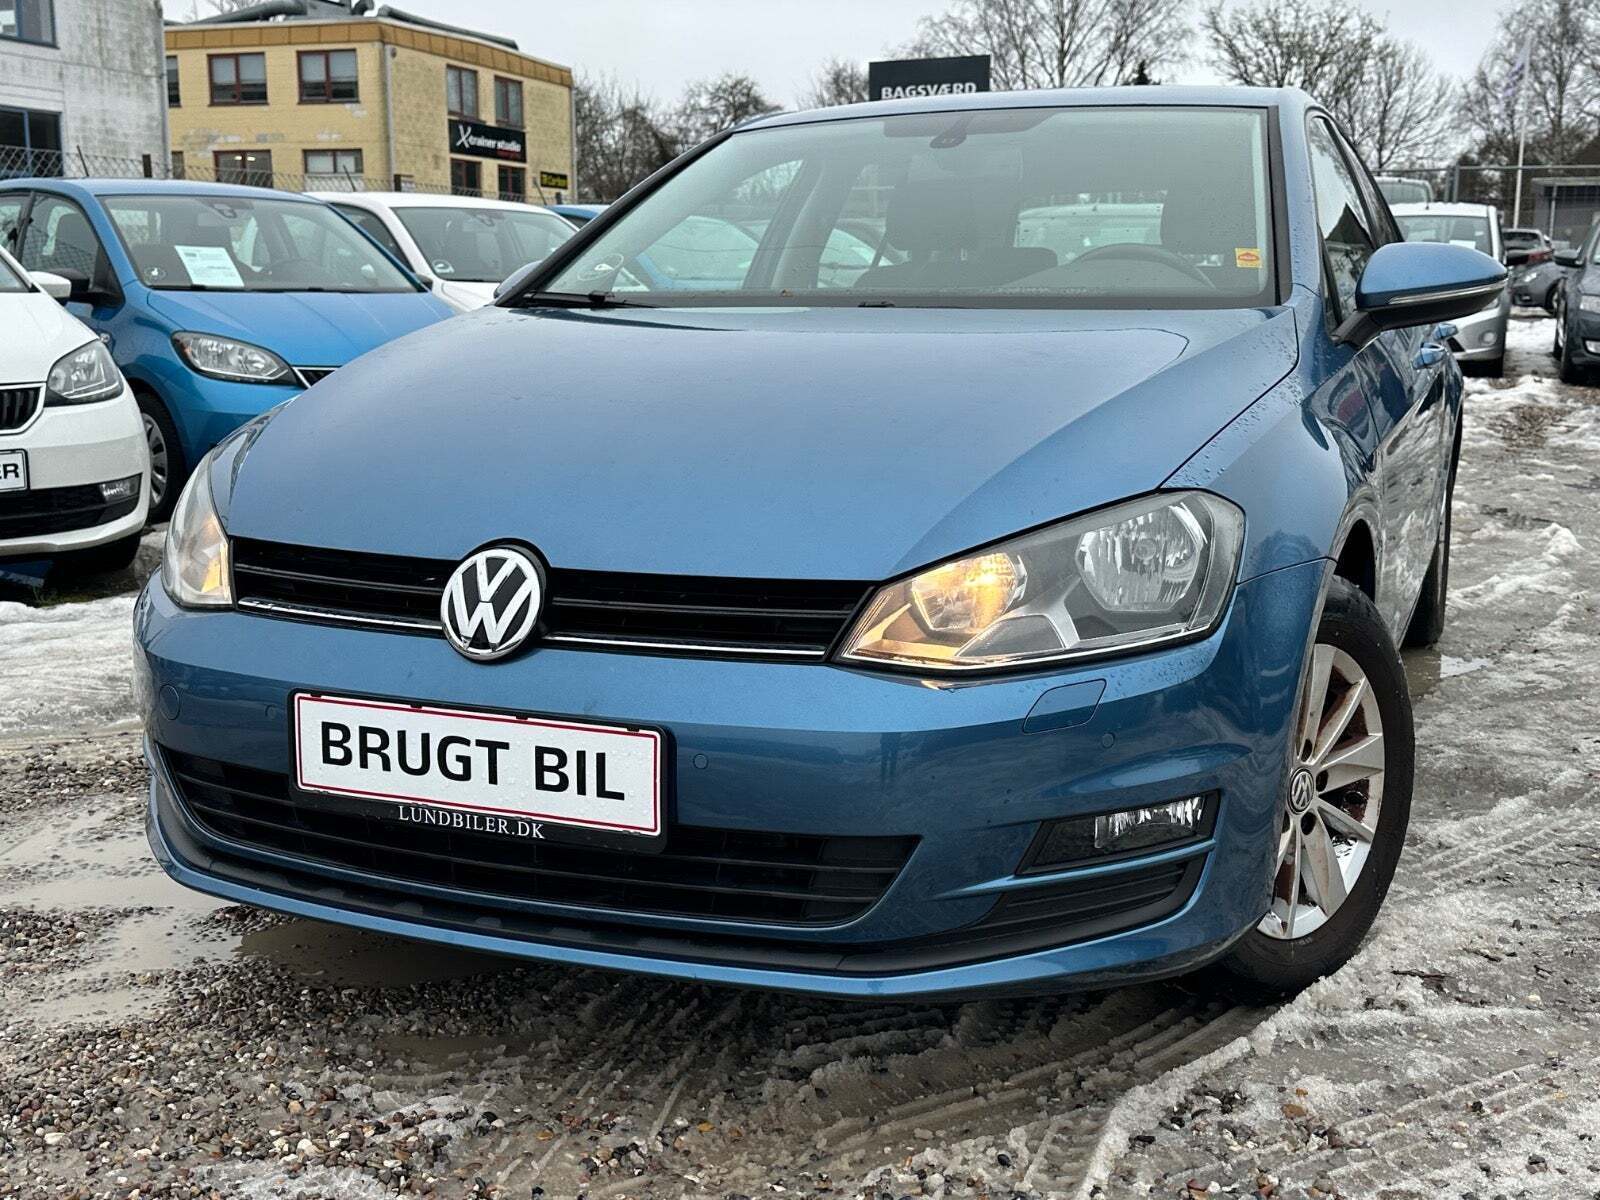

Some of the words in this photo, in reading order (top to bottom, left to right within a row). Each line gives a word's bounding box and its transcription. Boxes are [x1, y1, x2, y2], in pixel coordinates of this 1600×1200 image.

[0, 463, 19, 479] R
[442, 550, 540, 653] VW
[321, 721, 510, 786] BRUGT
[534, 745, 625, 801] BIL
[398, 806, 546, 839] LUNDBILER.DK
